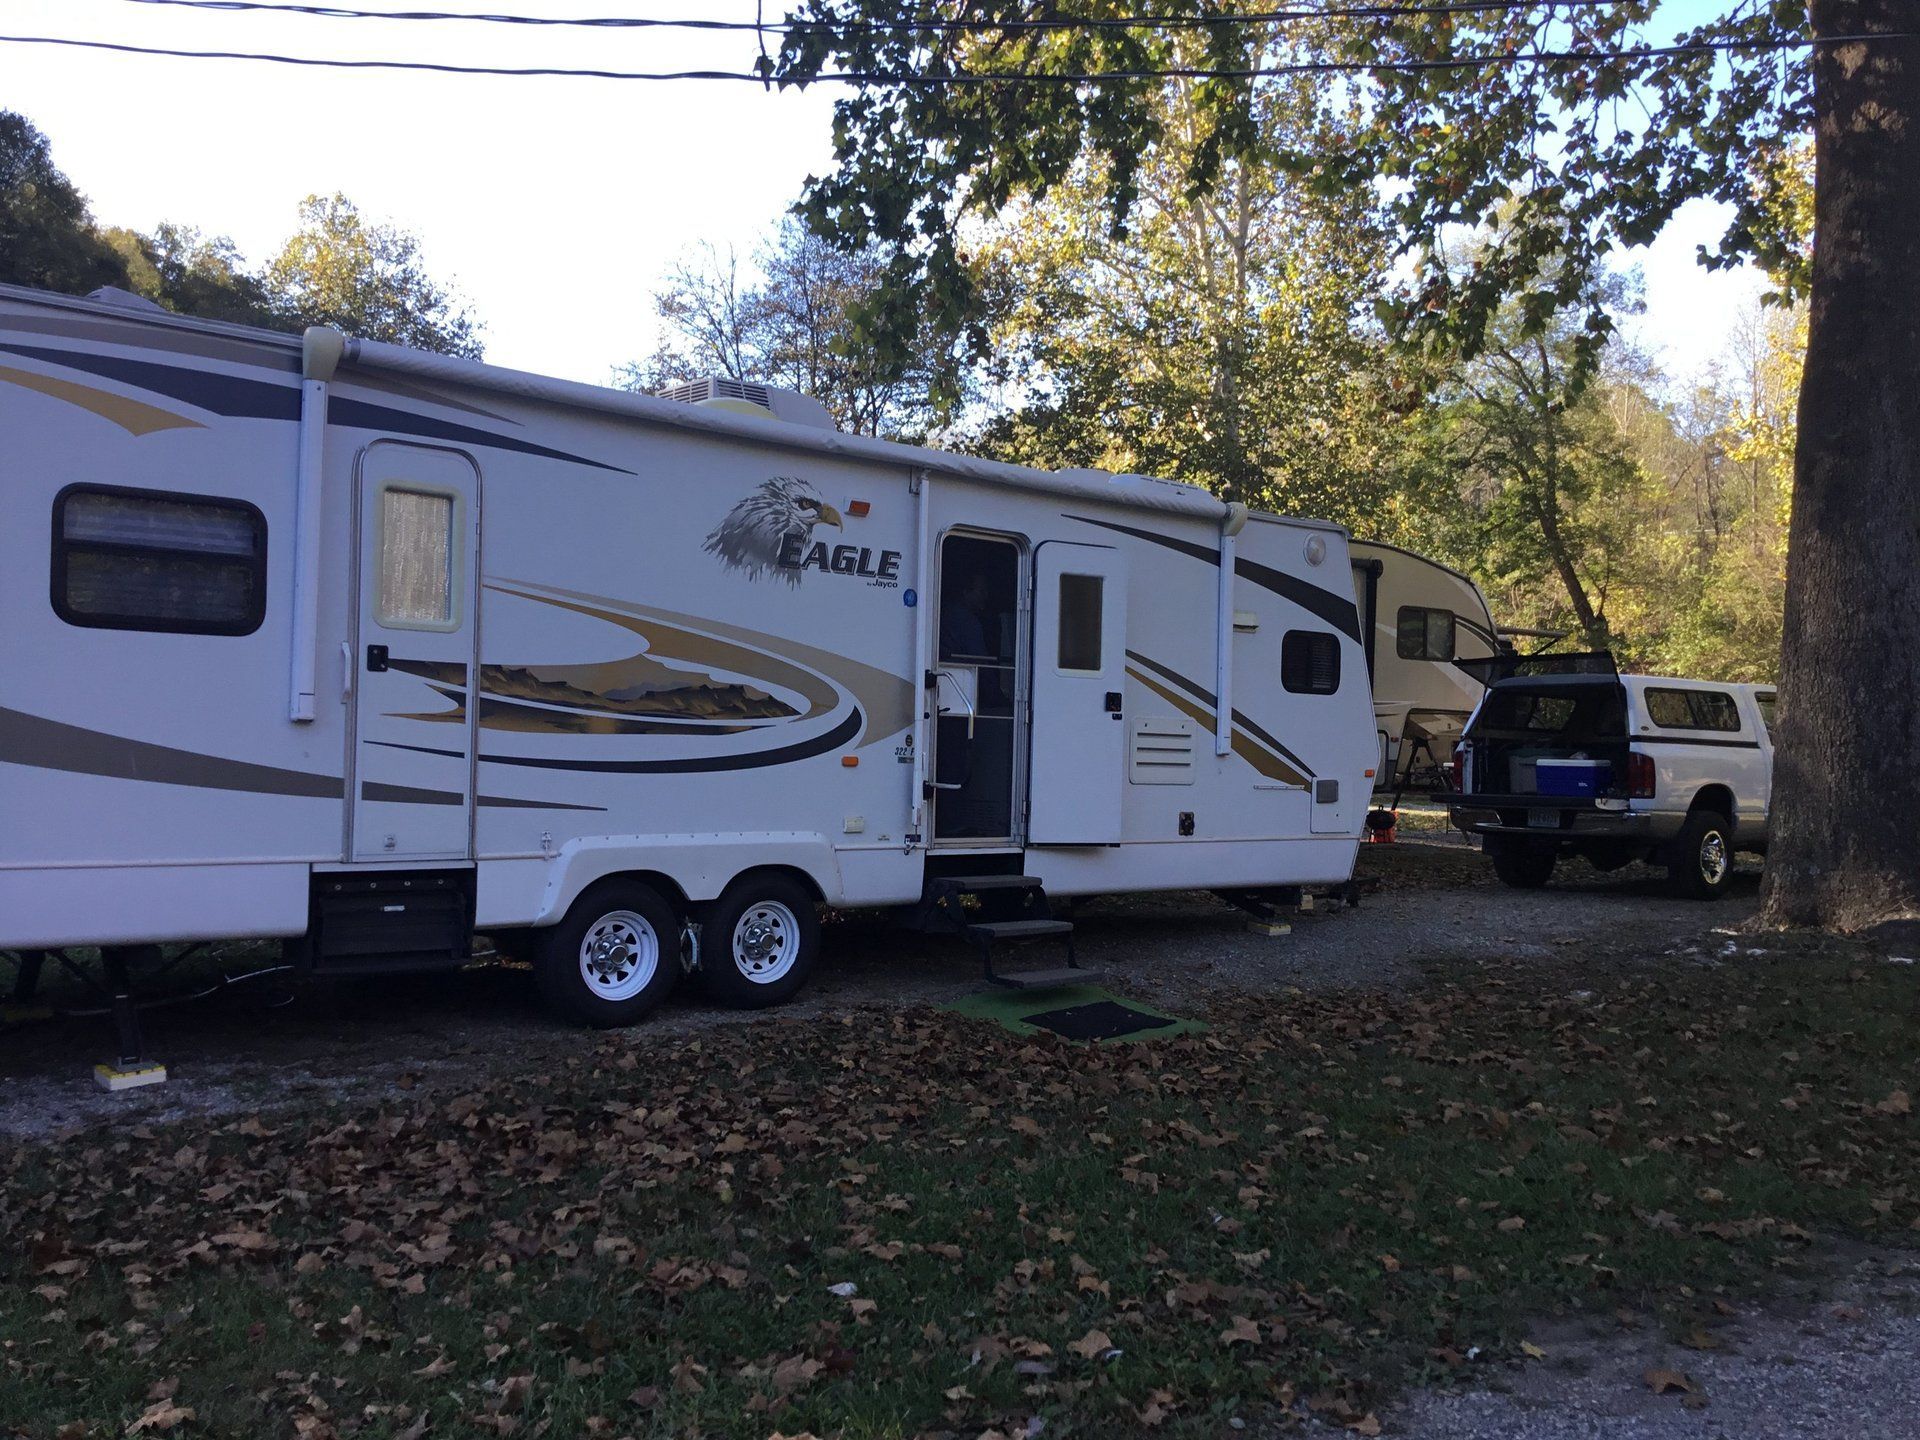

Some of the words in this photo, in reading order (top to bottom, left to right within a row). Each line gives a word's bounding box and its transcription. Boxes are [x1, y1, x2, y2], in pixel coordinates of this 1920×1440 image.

[777, 532, 902, 580] EAGLE
[873, 579, 898, 589] Jayco
[895, 747, 907, 756] 322
